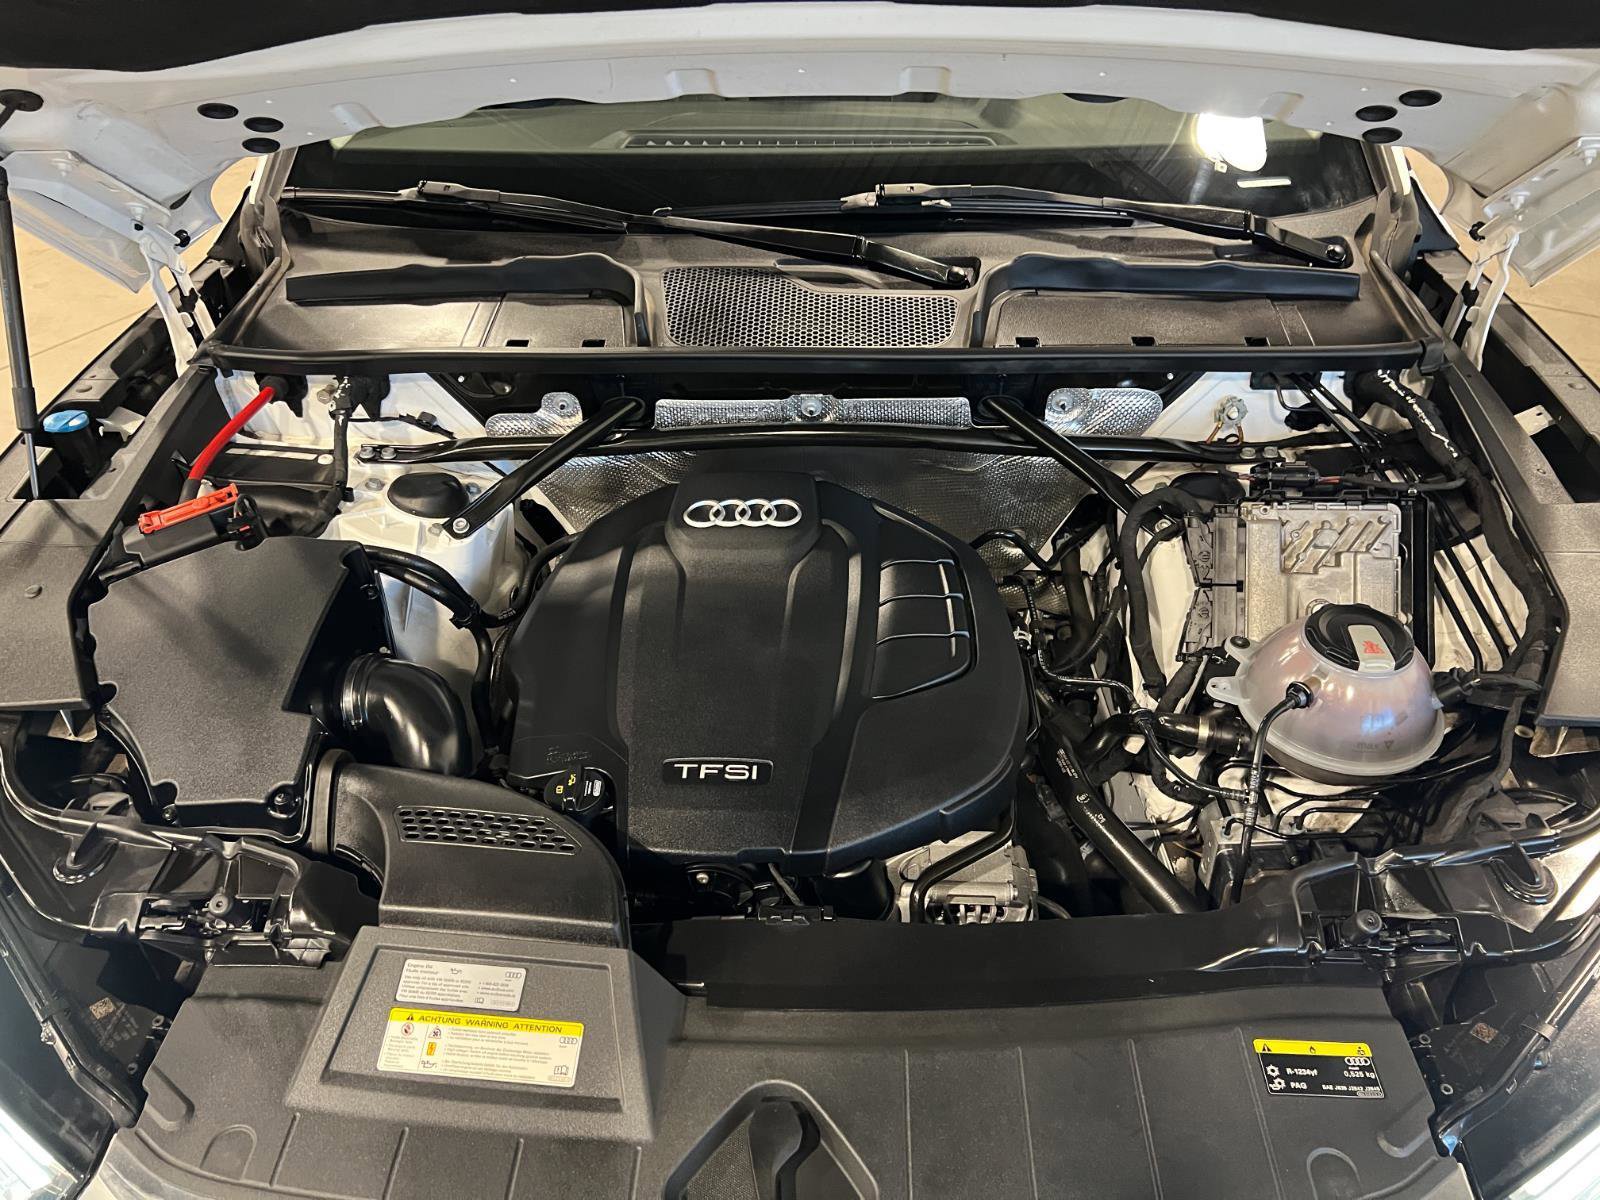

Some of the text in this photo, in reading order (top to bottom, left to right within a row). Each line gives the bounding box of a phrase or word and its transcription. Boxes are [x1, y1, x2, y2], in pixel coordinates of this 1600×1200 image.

[673, 763, 758, 780] TFSI
[418, 1015, 562, 1033] ACHTUNG WARNING ATTENTION
[1365, 1071, 1376, 1079] kg
[1289, 1081, 1308, 1090] PAG
